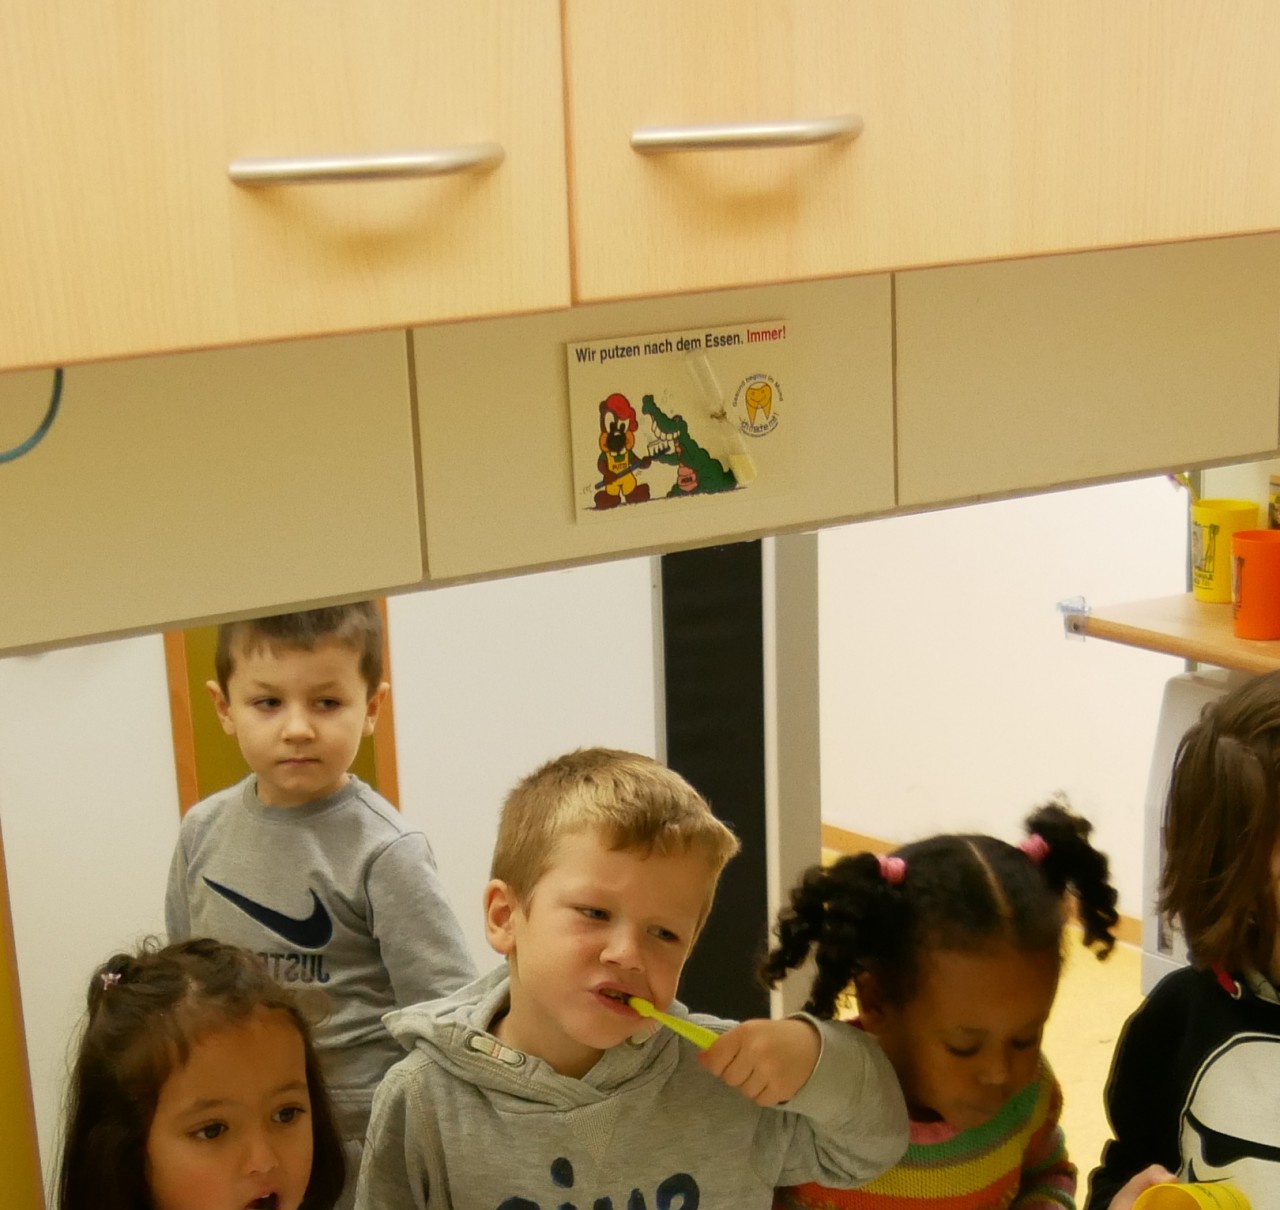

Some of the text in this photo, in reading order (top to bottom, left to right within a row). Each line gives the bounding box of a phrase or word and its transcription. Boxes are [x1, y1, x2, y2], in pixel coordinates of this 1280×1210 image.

[575, 325, 786, 364] Wir putzen nach dem Essen. Immer!
